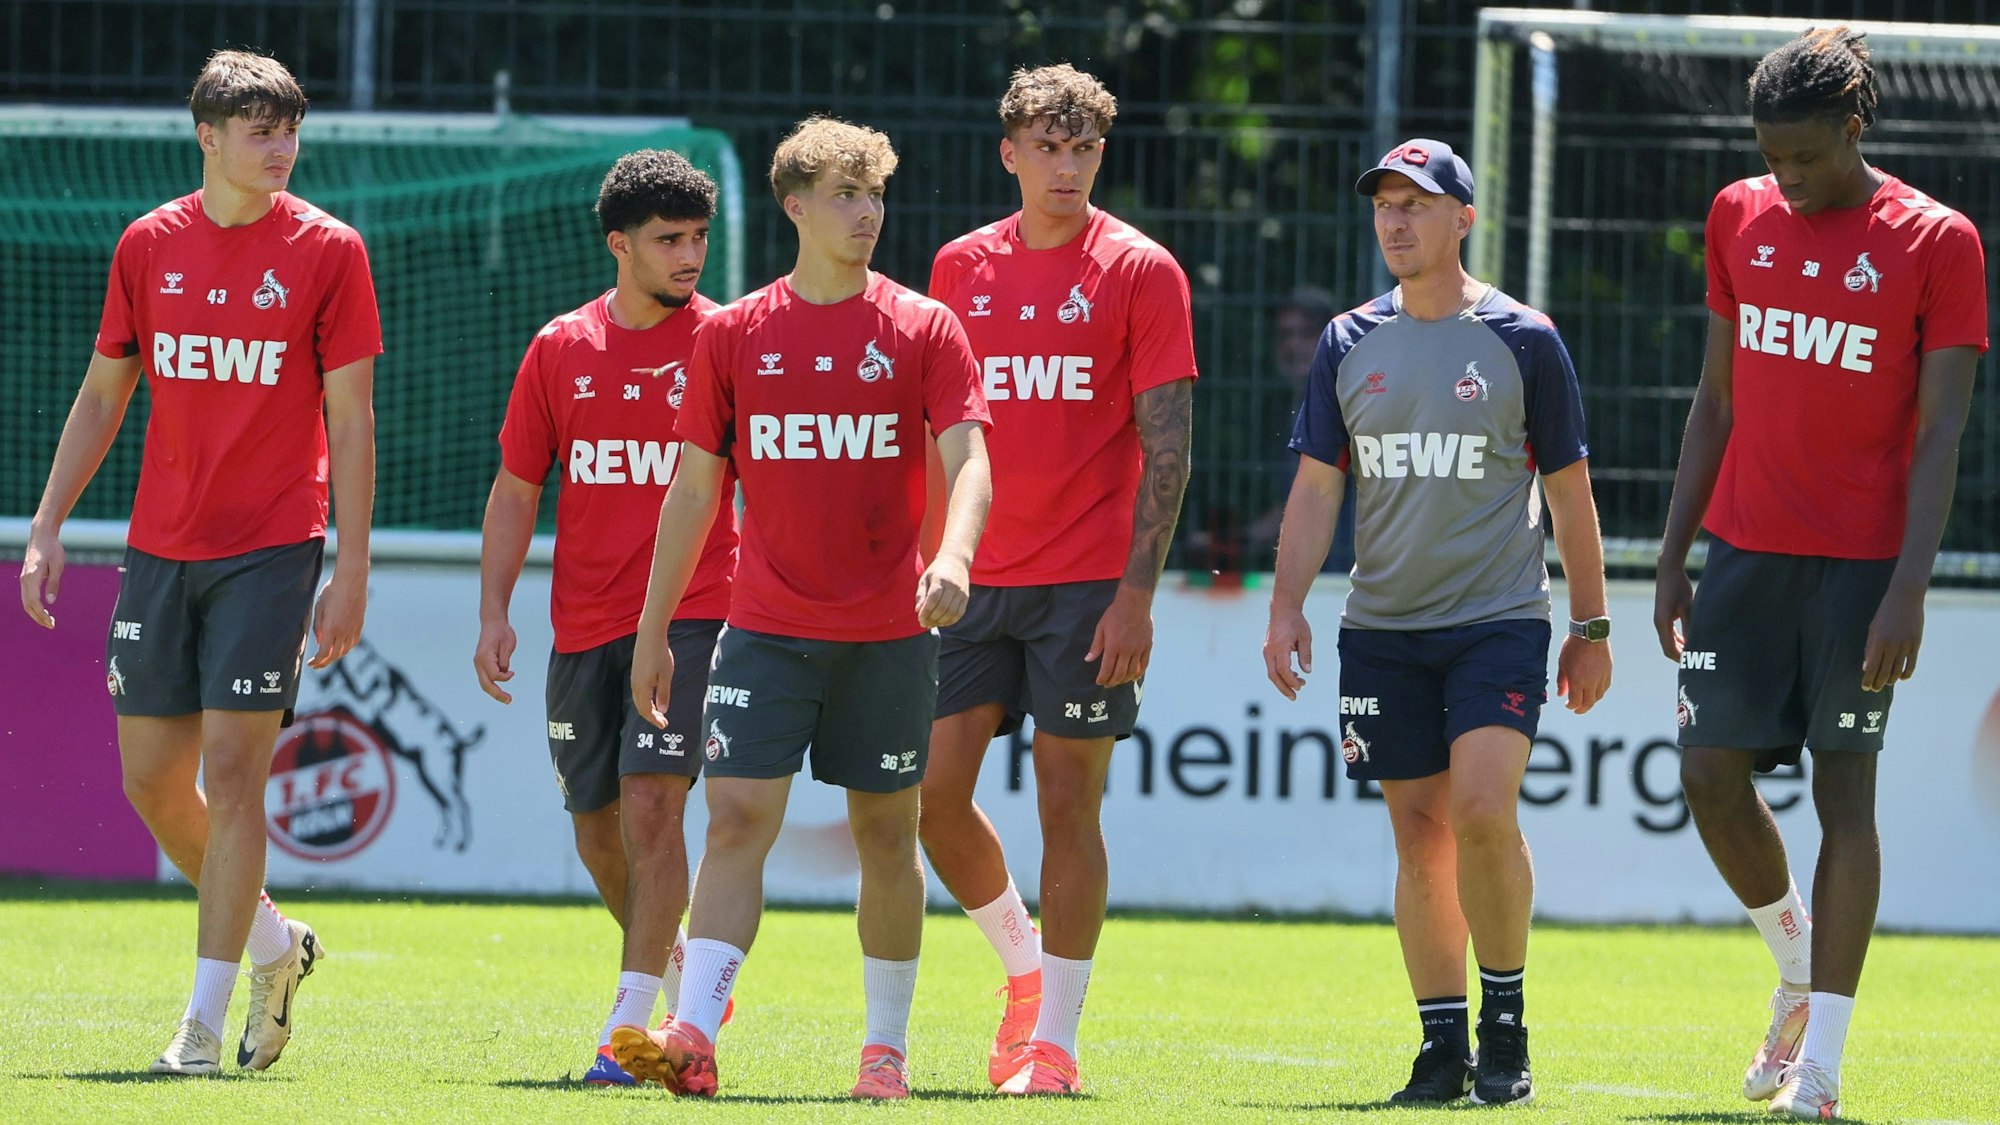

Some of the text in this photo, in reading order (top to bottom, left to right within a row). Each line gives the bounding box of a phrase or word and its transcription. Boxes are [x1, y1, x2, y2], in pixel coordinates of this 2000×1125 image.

[1384, 144, 1429, 168] FC
[1750, 259, 1774, 268] hummel
[1802, 260, 1820, 277] 38
[207, 289, 227, 304] 43
[968, 309, 991, 317] hummel
[1020, 305, 1035, 320] 24
[1739, 303, 1878, 374] REWE
[153, 331, 287, 385] REWE
[815, 356, 833, 371] 36
[757, 367, 784, 376] hummel
[983, 355, 1094, 400] EWE
[573, 390, 595, 400] hummel
[623, 384, 640, 400] 34
[749, 413, 900, 460] REWE
[569, 439, 684, 485] REW
[1354, 432, 1488, 479] REWE
[113, 621, 142, 640] WE
[1680, 651, 1717, 670] EWE
[232, 679, 252, 695] 43
[1065, 702, 1082, 719] 24
[1339, 696, 1380, 716] EWE
[1087, 713, 1109, 723] hummel
[1838, 712, 1856, 728] 38
[637, 733, 654, 749] 34
[659, 748, 685, 757] hummel
[880, 753, 898, 771] 36
[720, 958, 739, 985] KÖLN
